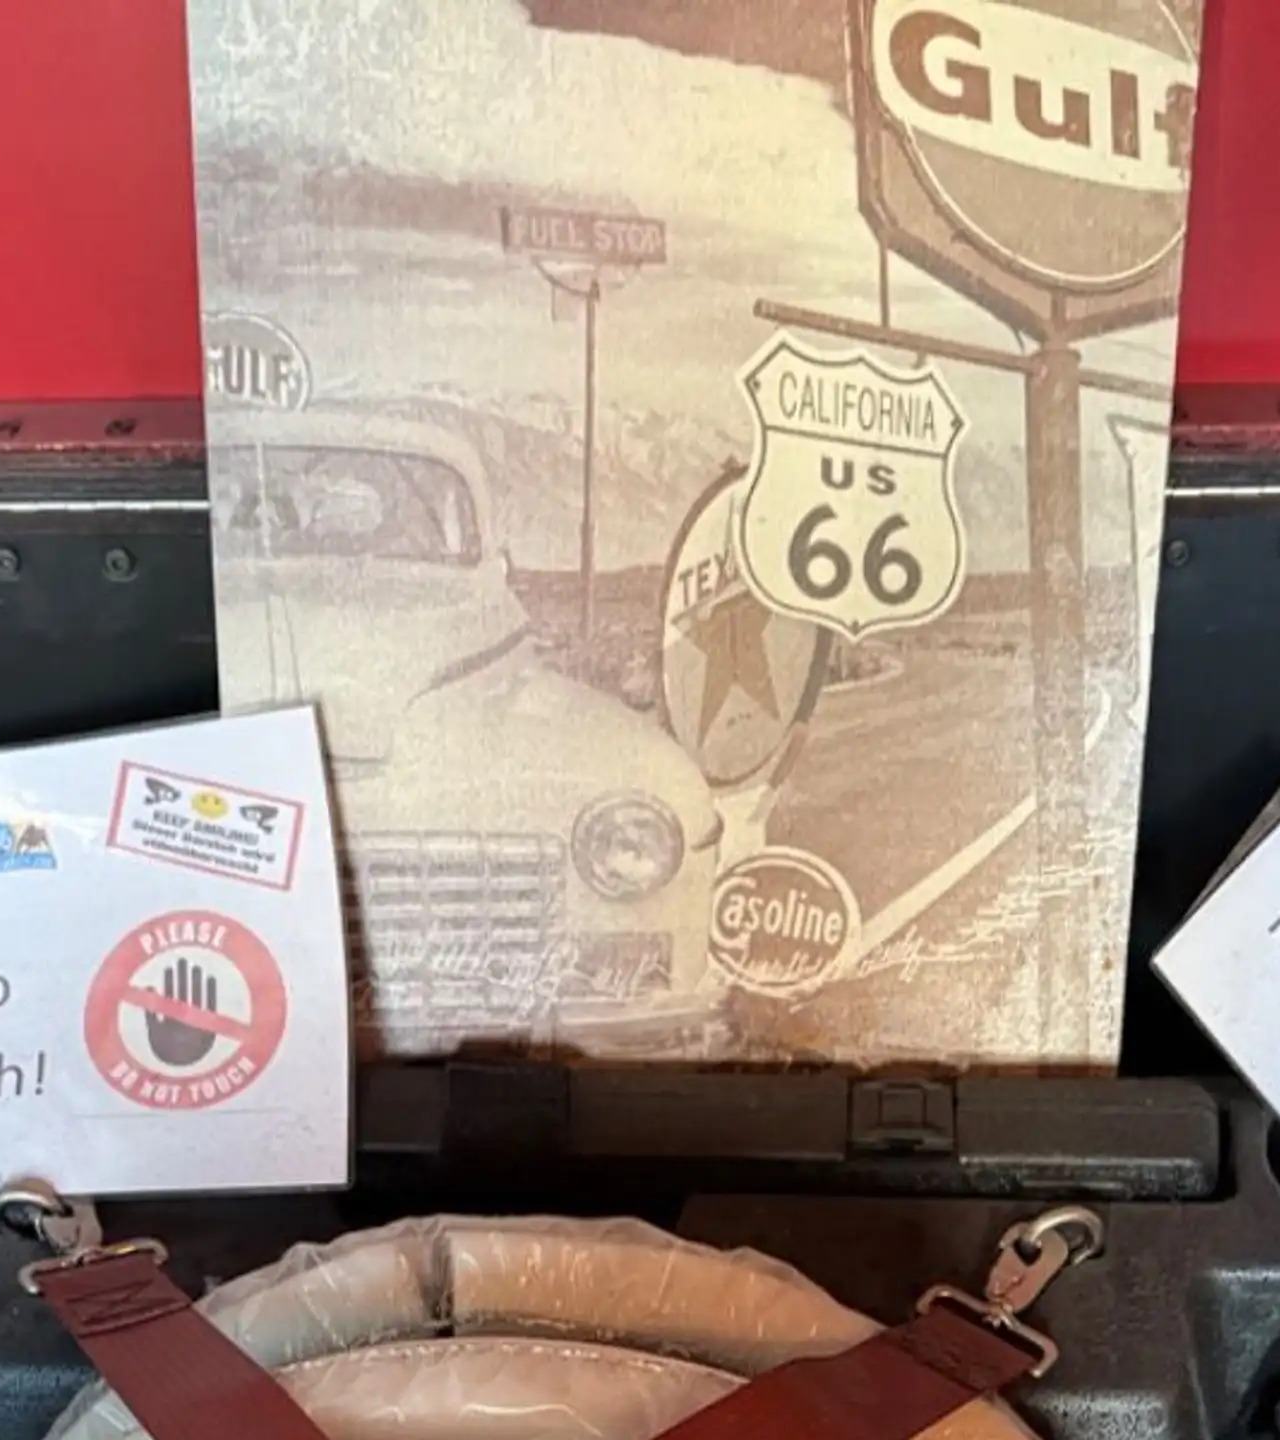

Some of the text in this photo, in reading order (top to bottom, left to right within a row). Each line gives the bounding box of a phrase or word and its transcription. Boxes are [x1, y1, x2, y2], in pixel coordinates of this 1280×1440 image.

[889, 9, 1196, 167] Gulf
[511, 214, 662, 253] FUEL STOP
[778, 370, 937, 443] CALIFORNIA
[820, 456, 898, 496] US
[787, 503, 922, 605] 66
[138, 919, 228, 956] PLEASE
[711, 875, 843, 952] Gasoline
[108, 1055, 259, 1105] DO NOT TOUCH
